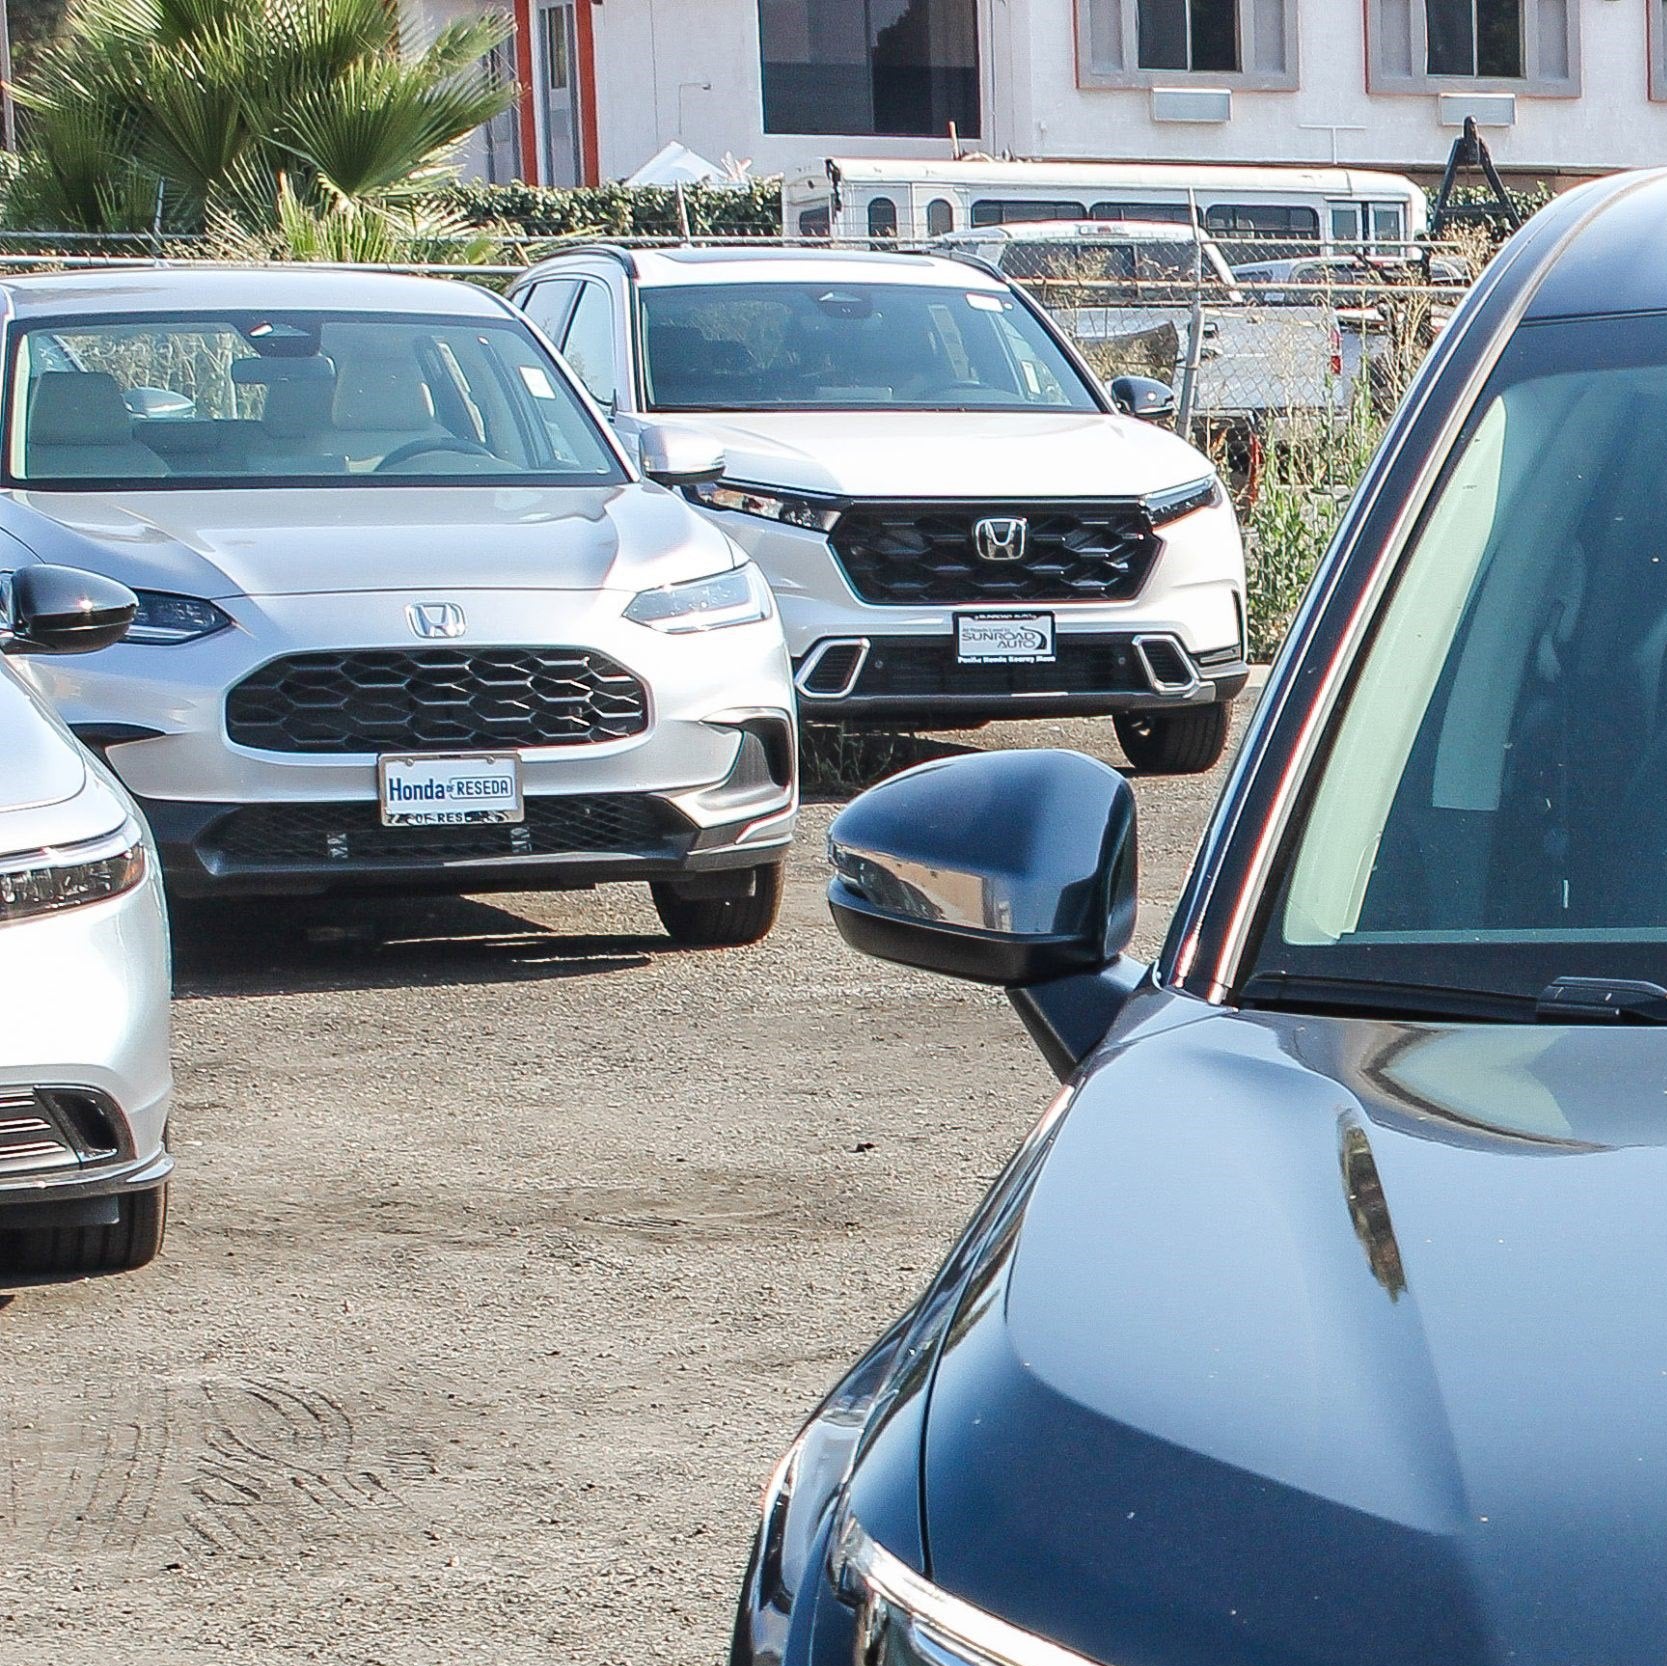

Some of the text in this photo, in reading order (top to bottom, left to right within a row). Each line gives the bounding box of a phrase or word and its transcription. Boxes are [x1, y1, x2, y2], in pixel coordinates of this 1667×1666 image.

[962, 631, 1036, 641] SUNROAD
[997, 640, 1036, 649] AUTO
[388, 777, 445, 801] Honda
[456, 780, 509, 796] RESEDA
